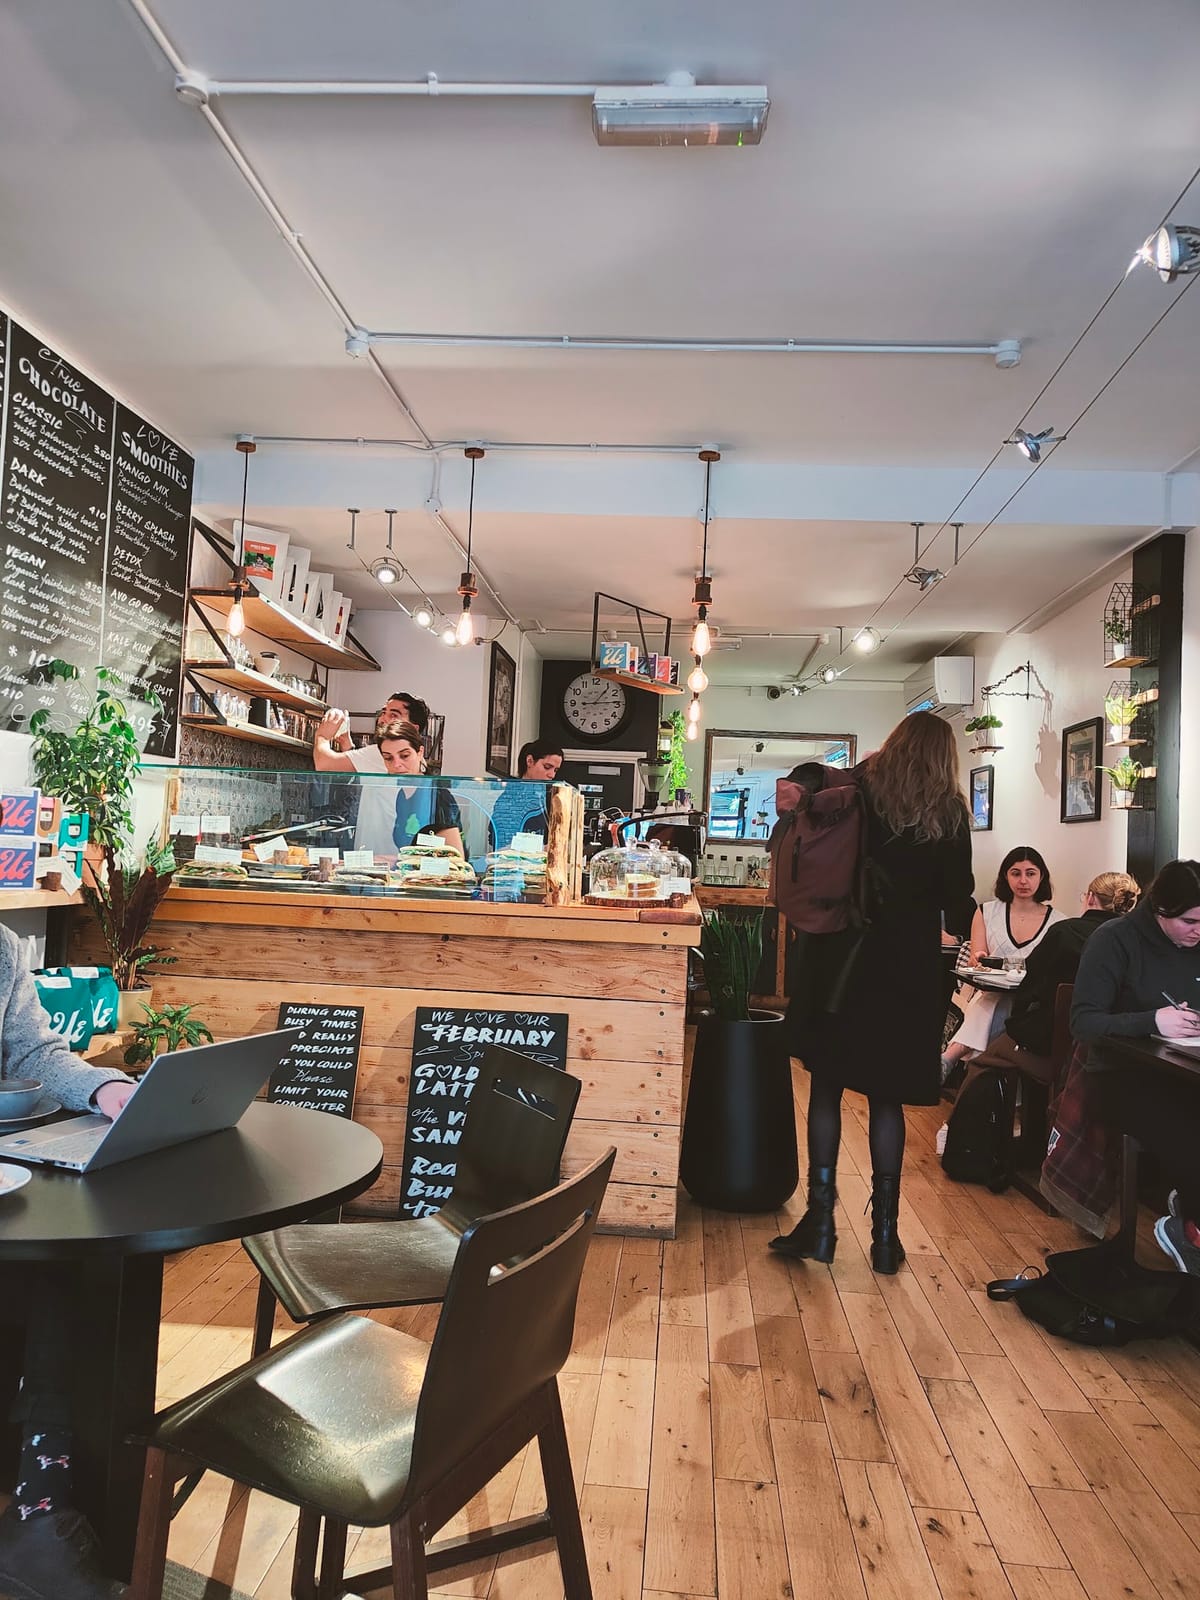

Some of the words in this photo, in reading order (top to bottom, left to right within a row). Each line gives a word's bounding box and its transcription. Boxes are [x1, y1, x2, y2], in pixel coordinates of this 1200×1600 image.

[18, 357, 107, 433] CHOCOLATE
[13, 392, 62, 429] CLASSIC
[13, 407, 36, 428] Well
[13, 435, 30, 451] 30%
[14, 422, 36, 440] milk
[38, 439, 78, 467] chocolate
[120, 431, 188, 490] SMOOTHIES
[10, 457, 47, 486] DARK
[116, 456, 151, 483] MANGO
[153, 481, 170, 497] MIX
[7, 493, 19, 506] of
[56, 504, 79, 519] mild
[80, 516, 98, 531] taste
[115, 500, 143, 524] BERRY
[144, 521, 174, 543] SPLASH
[41, 522, 66, 546] fruity
[6, 544, 46, 569] VEGAN
[50, 542, 86, 564] chocolate
[114, 545, 142, 568] DETOX
[2, 576, 26, 591] dark
[4, 559, 38, 588] Organic
[3, 590, 27, 605] taste
[30, 602, 49, 614] with
[110, 588, 127, 602] AVO
[128, 598, 141, 608] GO
[142, 603, 154, 613] GO
[107, 632, 130, 647] KALE
[28, 648, 56, 668] IC
[153, 684, 174, 697] SPLIT
[592, 678, 600, 686] 12
[610, 711, 617, 719] 4
[286, 1006, 330, 1016] DURING
[333, 1009, 358, 1018] OUR
[432, 1011, 456, 1022] WE
[284, 1017, 313, 1026] BUSY
[320, 1020, 358, 1029] TIMES
[312, 1032, 355, 1041] REALLY
[420, 1024, 556, 1048] FEBRUARY
[288, 1044, 355, 1054] PPRECIATE
[295, 1059, 316, 1067] YOU
[317, 1061, 353, 1070] COULD
[290, 1069, 334, 1083] Please
[274, 1086, 311, 1095] LIMIT
[316, 1088, 349, 1098] YOUR
